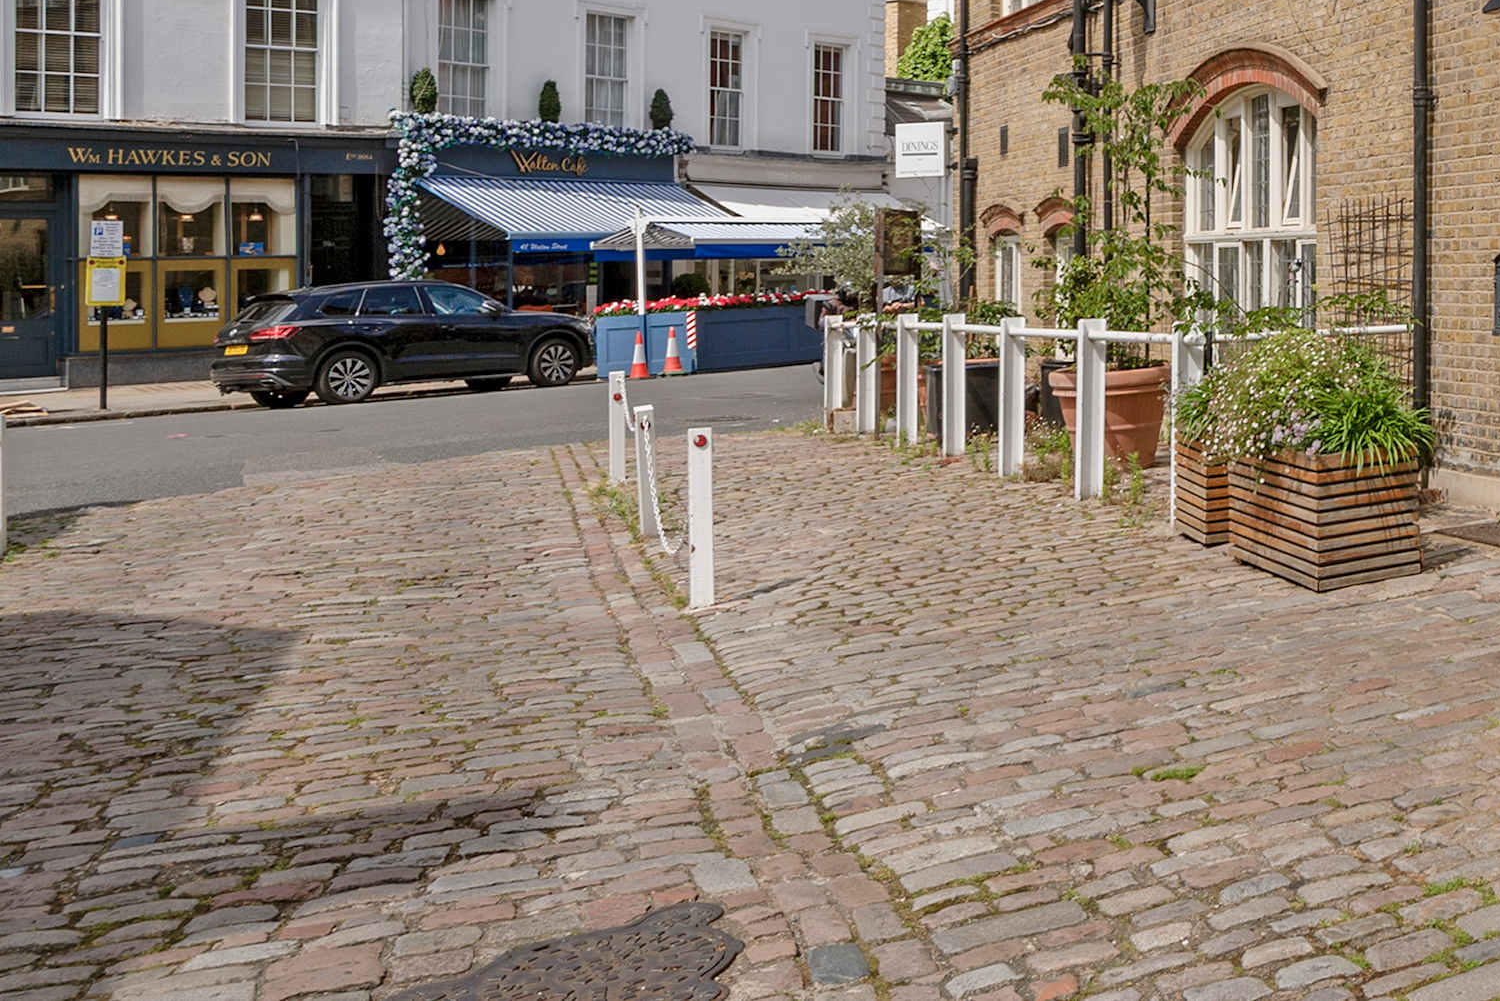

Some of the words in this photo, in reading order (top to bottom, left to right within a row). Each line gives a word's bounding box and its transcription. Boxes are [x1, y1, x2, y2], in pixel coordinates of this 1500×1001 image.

[902, 141, 938, 151] DININGS
[107, 149, 205, 166] HAWKES
[209, 154, 222, 166] &
[226, 151, 272, 167] SON
[511, 149, 560, 173] Walton
